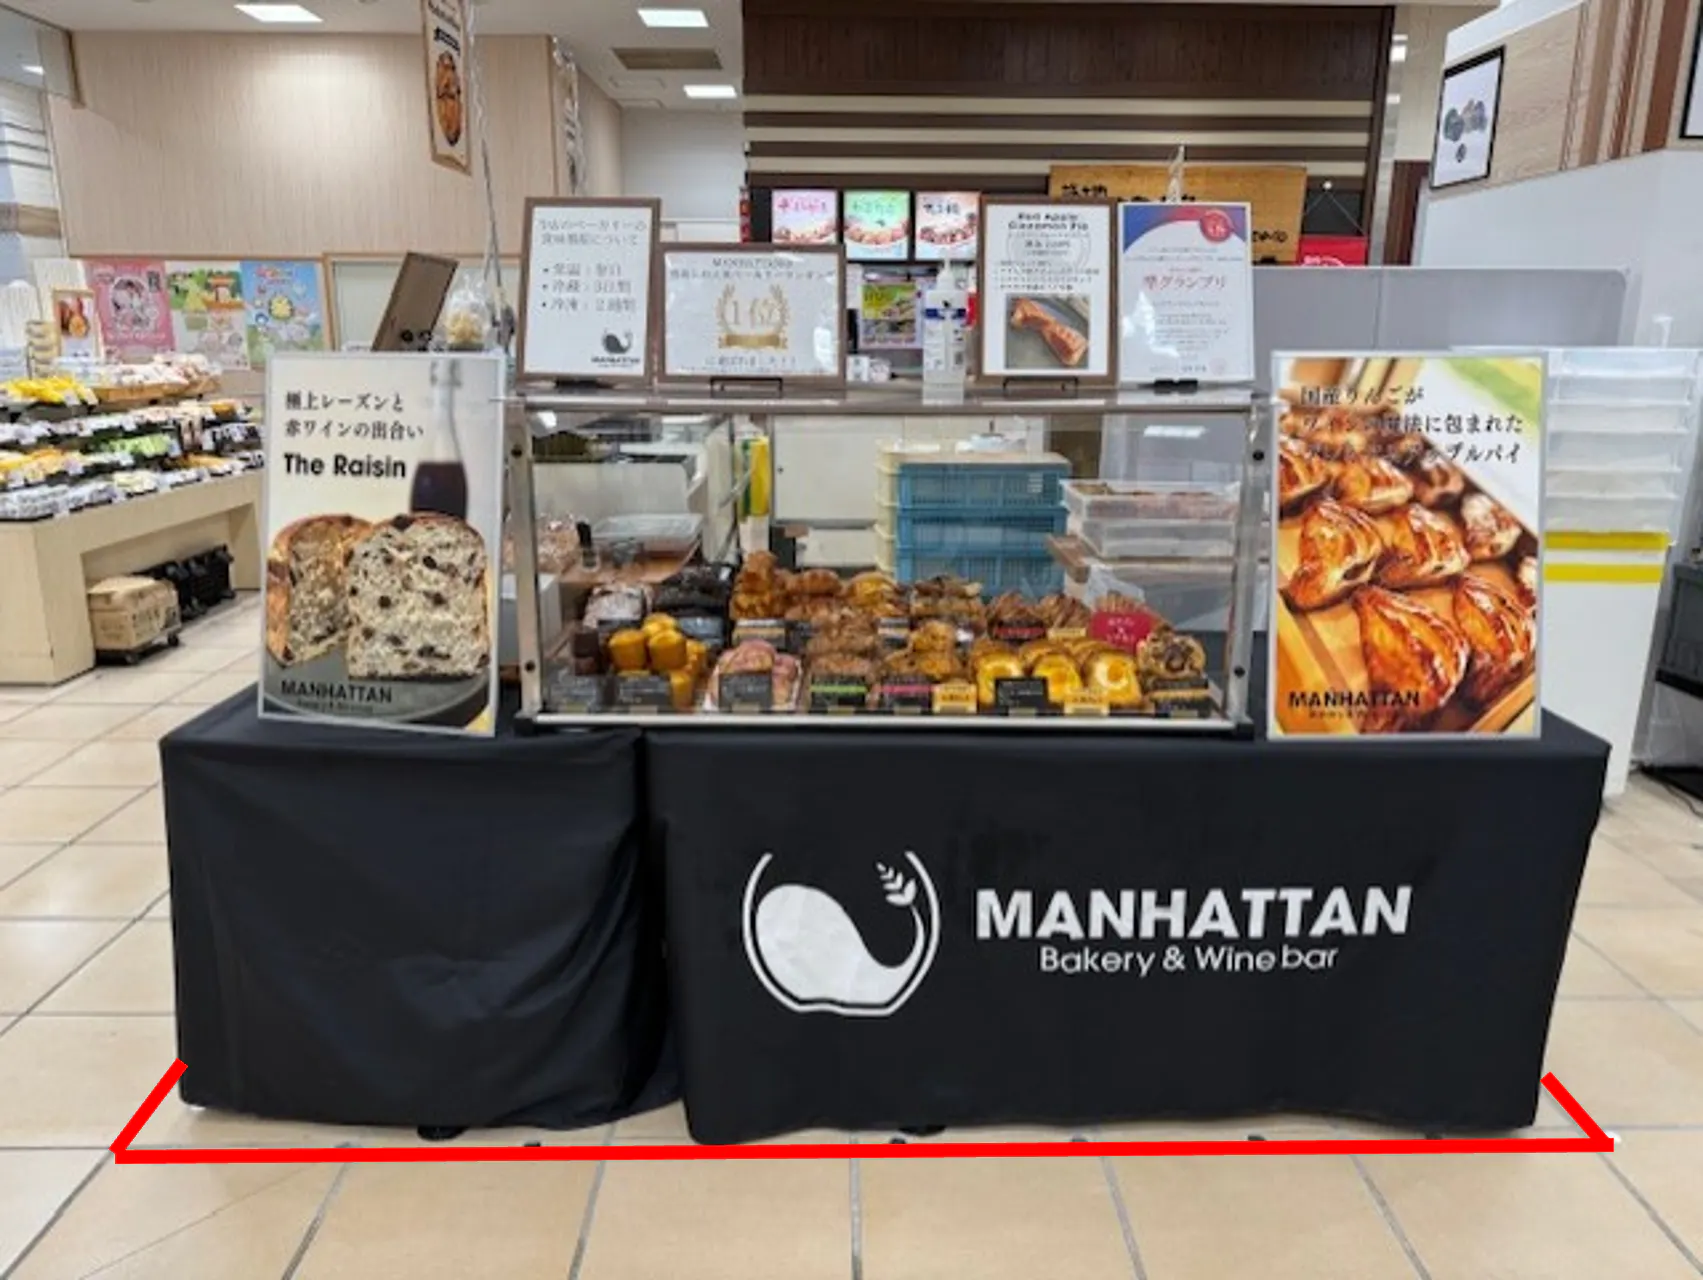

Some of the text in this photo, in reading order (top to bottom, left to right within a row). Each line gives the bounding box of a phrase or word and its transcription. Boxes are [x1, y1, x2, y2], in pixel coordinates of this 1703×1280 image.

[283, 452, 406, 478] The Raisin
[280, 679, 392, 703] MANHATTAN
[1286, 690, 1420, 708] MANHATTAN
[976, 886, 1411, 940] MANHATTAN
[1040, 945, 1156, 978] Bakery
[1162, 945, 1186, 972] &
